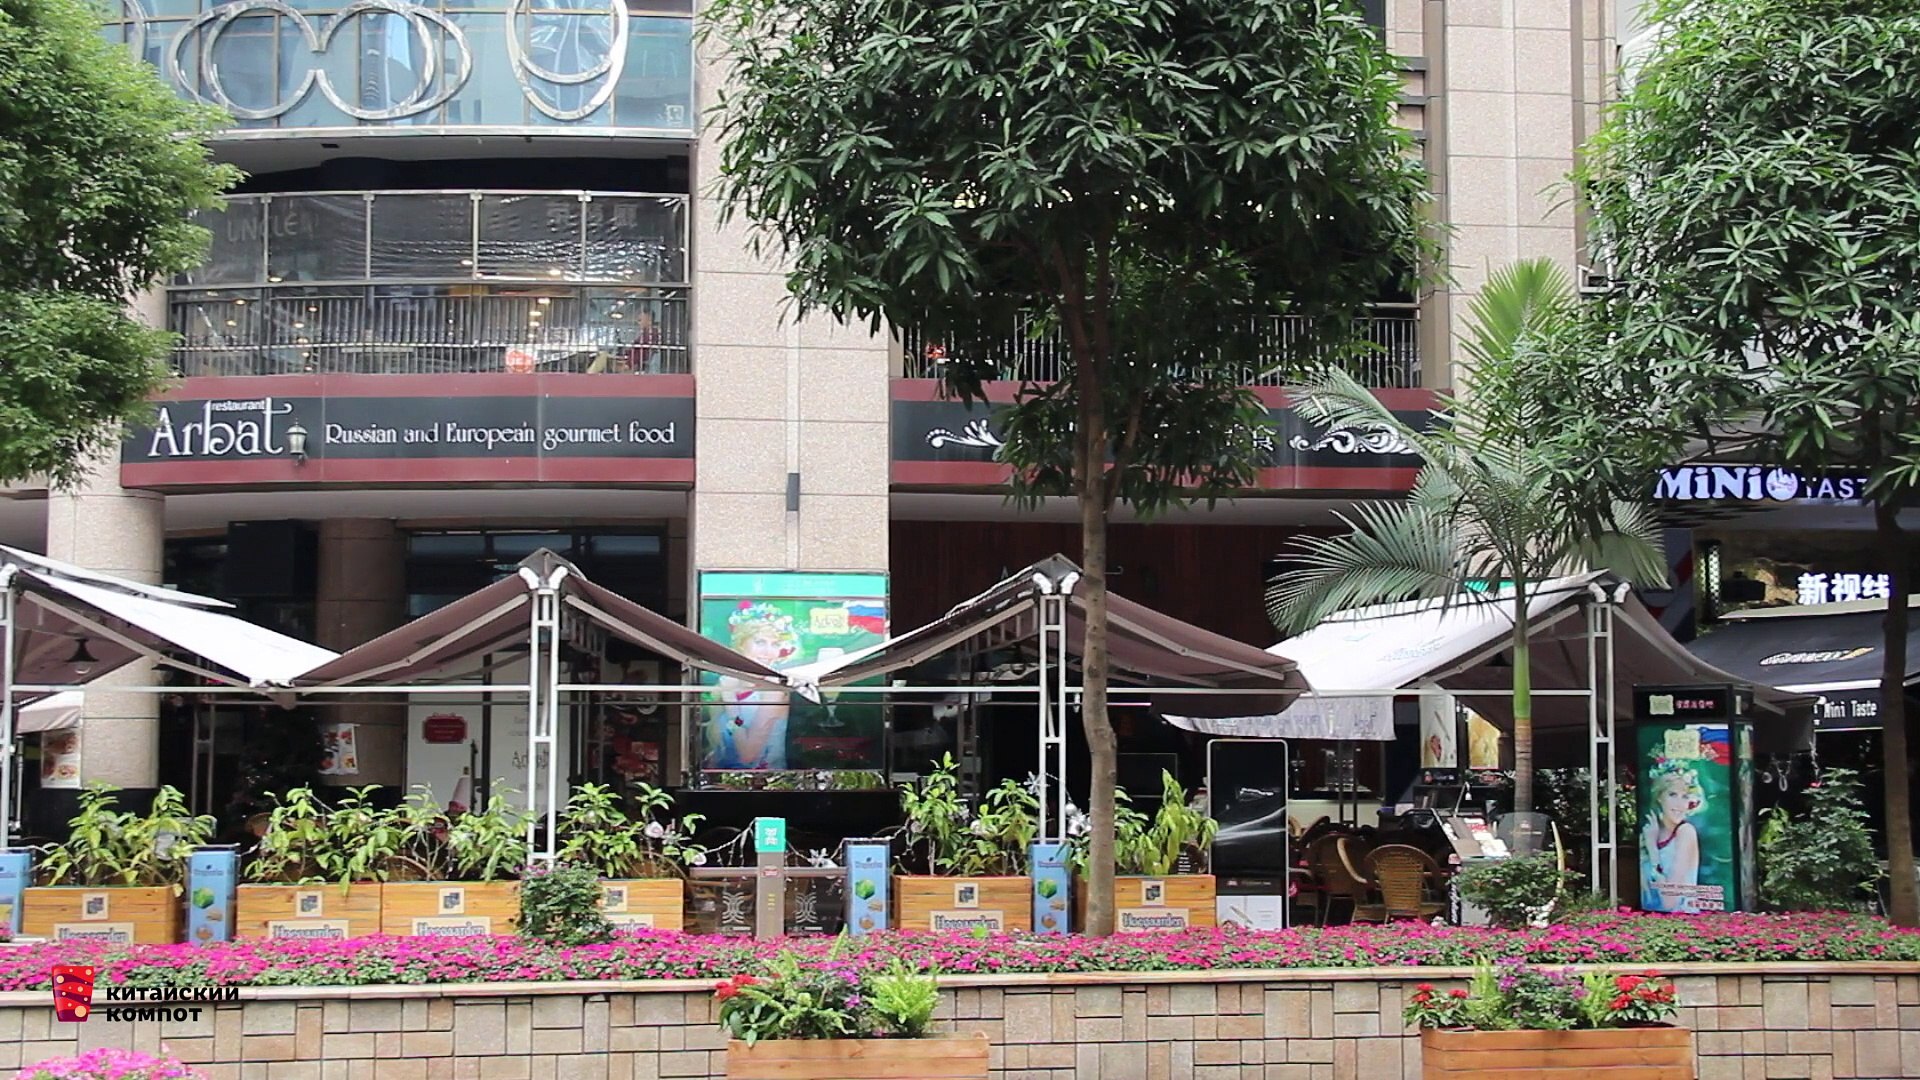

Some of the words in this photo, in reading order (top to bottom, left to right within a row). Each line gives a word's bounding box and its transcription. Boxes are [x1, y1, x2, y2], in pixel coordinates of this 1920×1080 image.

[211, 399, 267, 411] restaurant
[147, 397, 293, 457] Arbat
[325, 423, 397, 444] Russian
[403, 422, 439, 443] and
[446, 421, 535, 450] European
[542, 423, 622, 451] gourmet
[628, 420, 675, 444] food
[1797, 572, 1890, 606] 新视线
[1851, 699, 1878, 718] Taste
